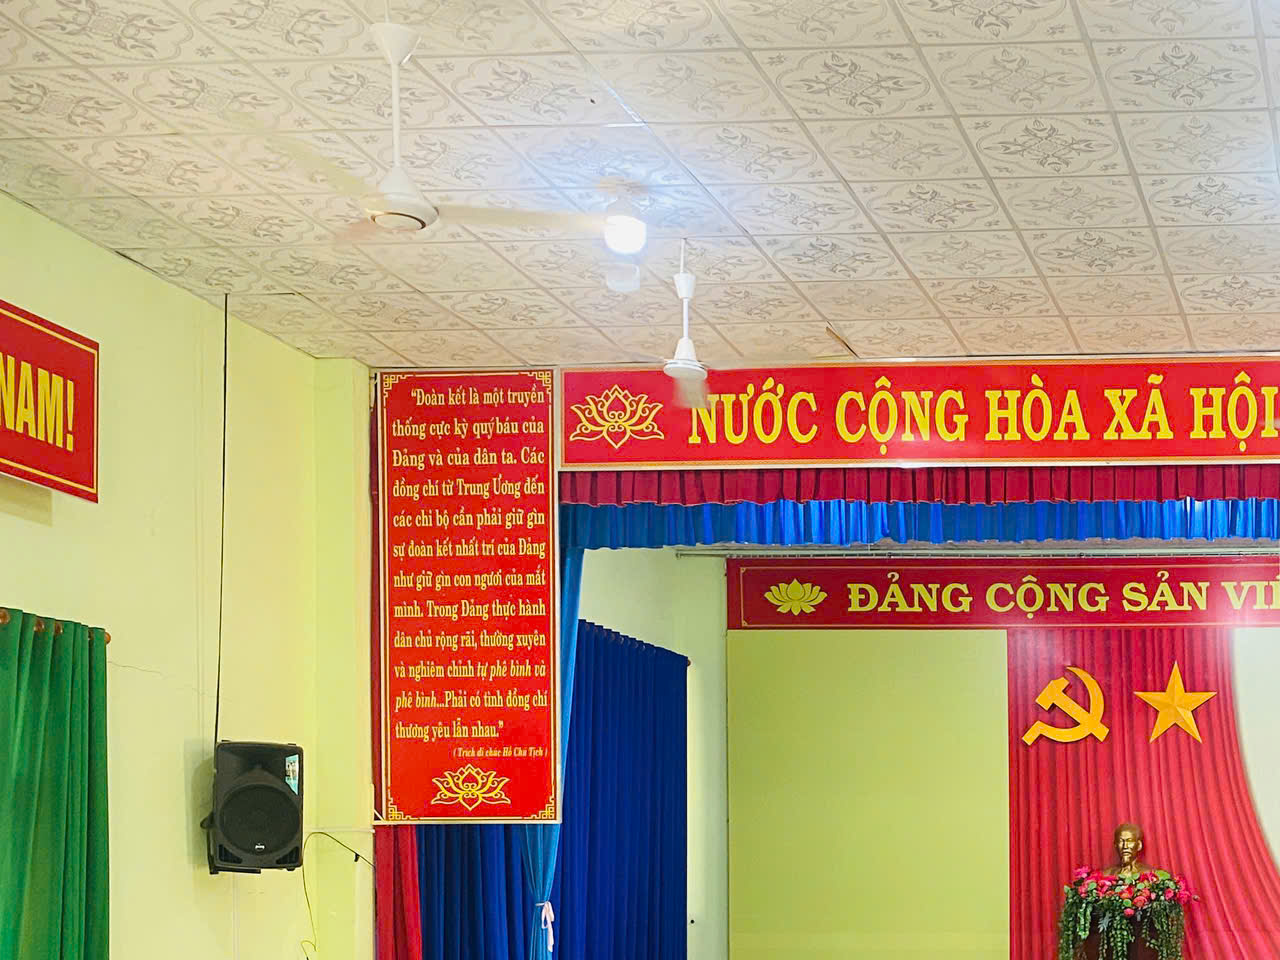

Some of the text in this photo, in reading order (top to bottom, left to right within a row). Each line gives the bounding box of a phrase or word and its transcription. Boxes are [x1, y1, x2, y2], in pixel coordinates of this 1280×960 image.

[0, 353, 74, 452] NAM!
[448, 385, 466, 405] kết
[469, 387, 479, 404] là
[483, 388, 504, 407] một
[508, 384, 544, 407] truyền
[688, 377, 818, 444] NƯỚC
[836, 375, 968, 455] CỘNG
[984, 374, 1091, 441] HÒA
[1103, 374, 1174, 440] XÃ
[1190, 371, 1279, 451] HỘI
[392, 416, 544, 440] thống cực kỳ quý báu của
[392, 447, 544, 470] Đảng và của dân ta. Các
[393, 474, 544, 501] đồng chí từ Trung Ương đến
[847, 572, 973, 613] ĐẢNG
[986, 575, 1110, 620] CỘNG
[1122, 569, 1210, 613] SẢN
[394, 599, 546, 621] mình. Trong Đảng thực hành
[395, 721, 429, 742] thương
[432, 722, 450, 742] yêu
[453, 718, 469, 737] lẫn
